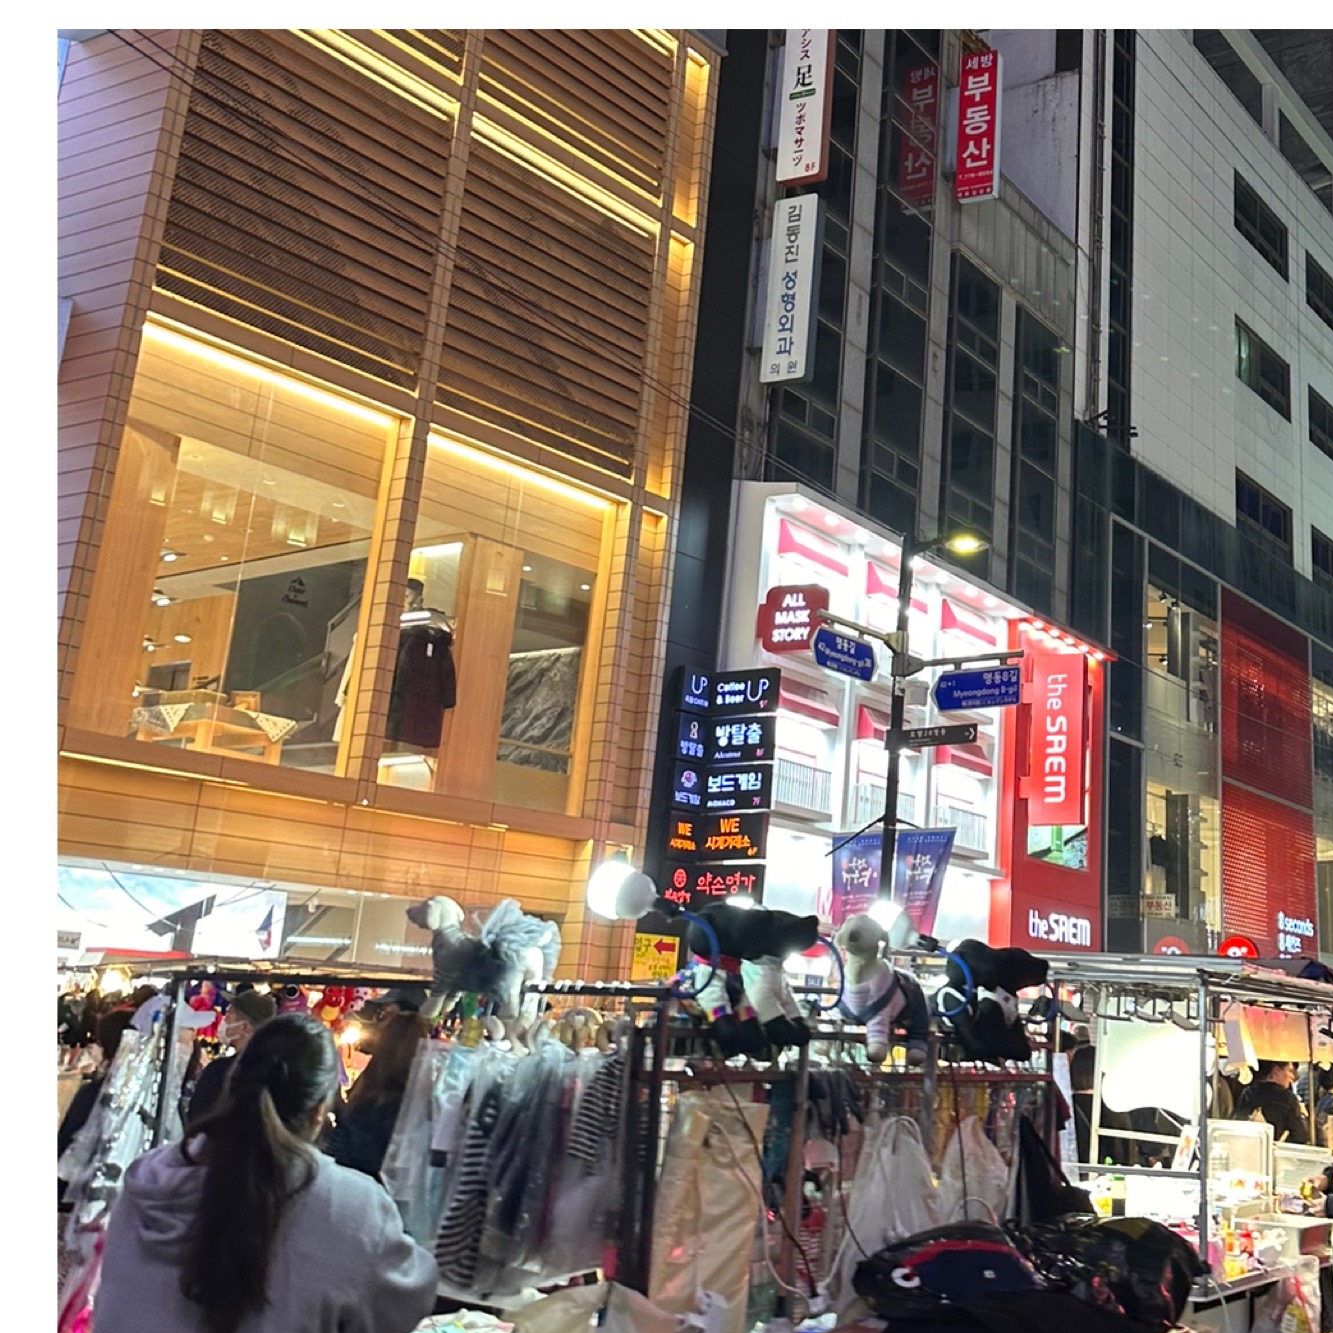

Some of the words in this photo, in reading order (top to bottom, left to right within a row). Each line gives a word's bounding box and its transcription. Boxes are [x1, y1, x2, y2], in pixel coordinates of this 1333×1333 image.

[965, 54, 994, 70] 세방
[962, 72, 992, 168] 부동산
[785, 204, 802, 264] 김동진
[777, 270, 798, 356] 성형외과
[769, 360, 797, 376] 의원
[782, 592, 805, 607] ALL
[775, 609, 810, 625] MASK
[771, 627, 810, 643] STORY
[1047, 674, 1067, 709] the
[715, 722, 762, 747] 방탈출
[1045, 715, 1066, 805] SAEM
[707, 771, 762, 793] 보드게임
[677, 822, 693, 836] WE
[720, 818, 741, 833] WE
[696, 871, 755, 895] 약손명가
[1029, 909, 1048, 938] the
[1048, 914, 1091, 946] SAEM
